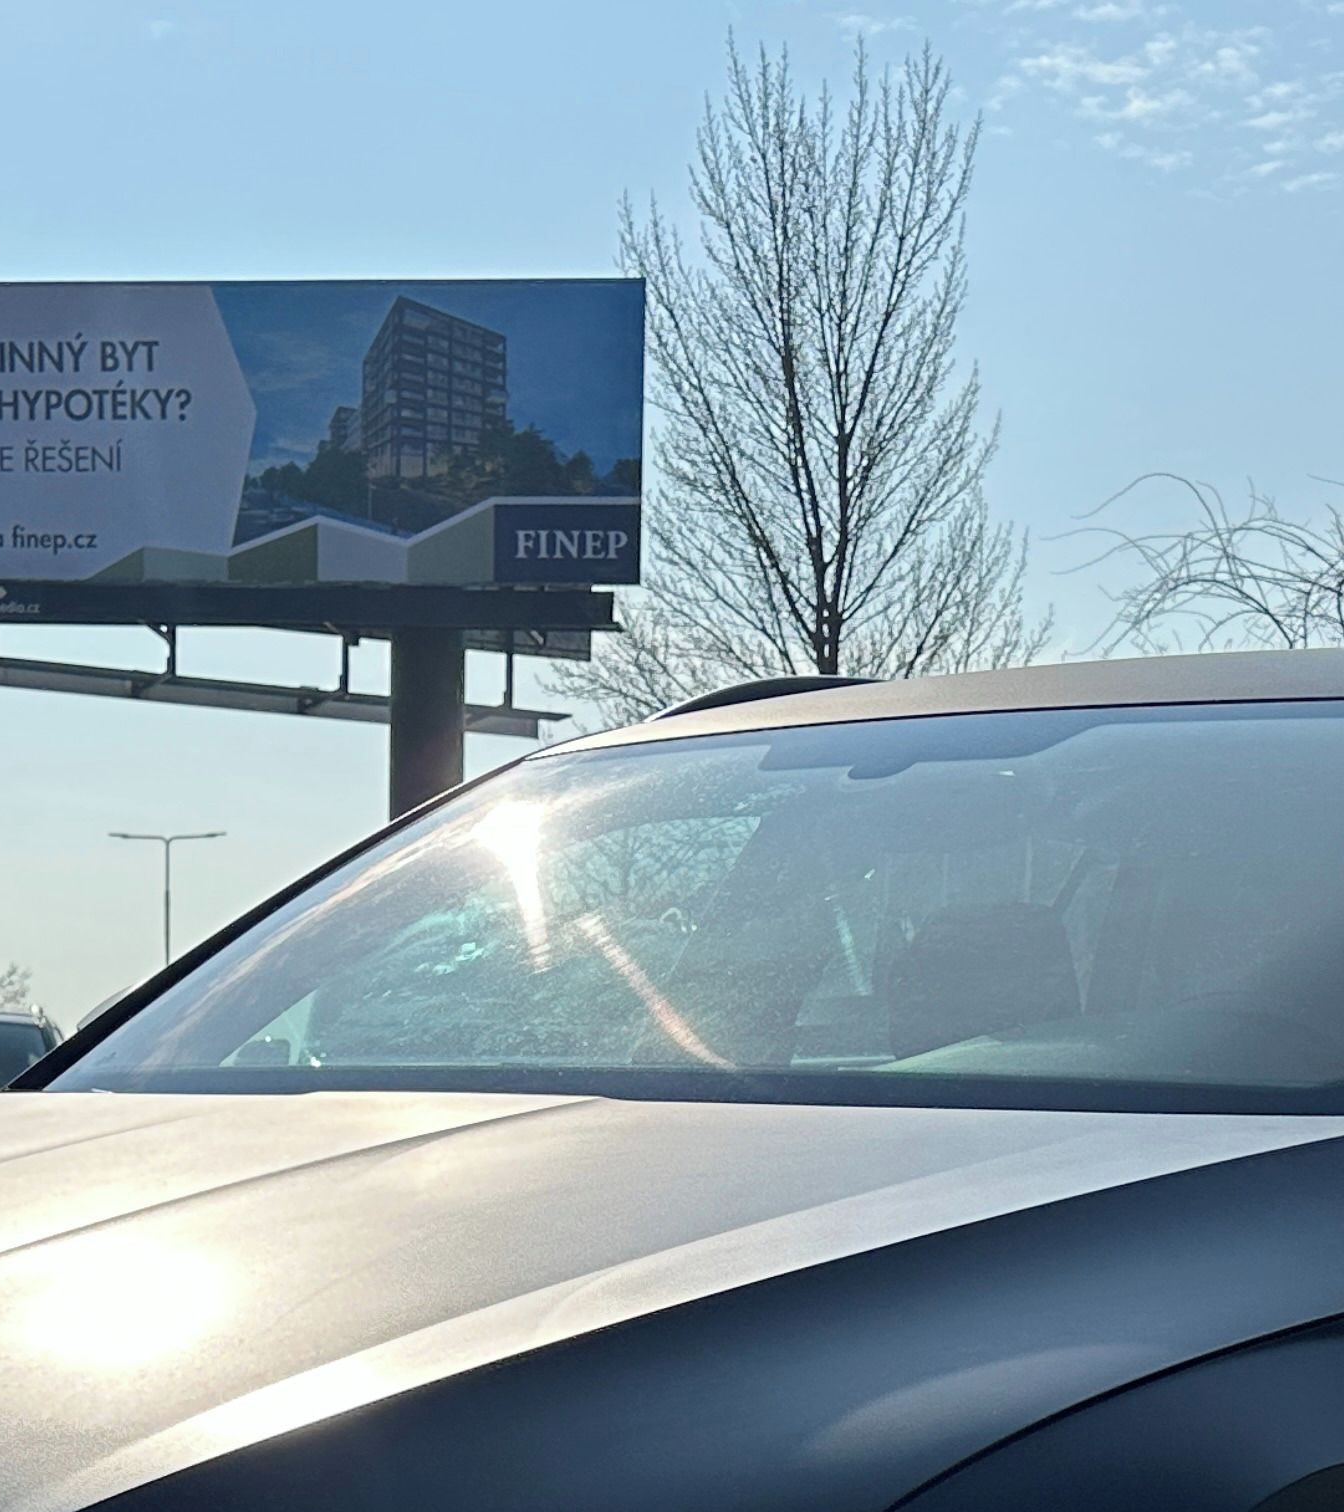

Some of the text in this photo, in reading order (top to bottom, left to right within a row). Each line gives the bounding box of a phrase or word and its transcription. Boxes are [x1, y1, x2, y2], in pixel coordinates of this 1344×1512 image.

[100, 340, 160, 373] BYT
[24, 438, 123, 473] ŘEŠENÍ
[12, 525, 98, 555] finep.cz
[514, 529, 629, 560] FINEP
